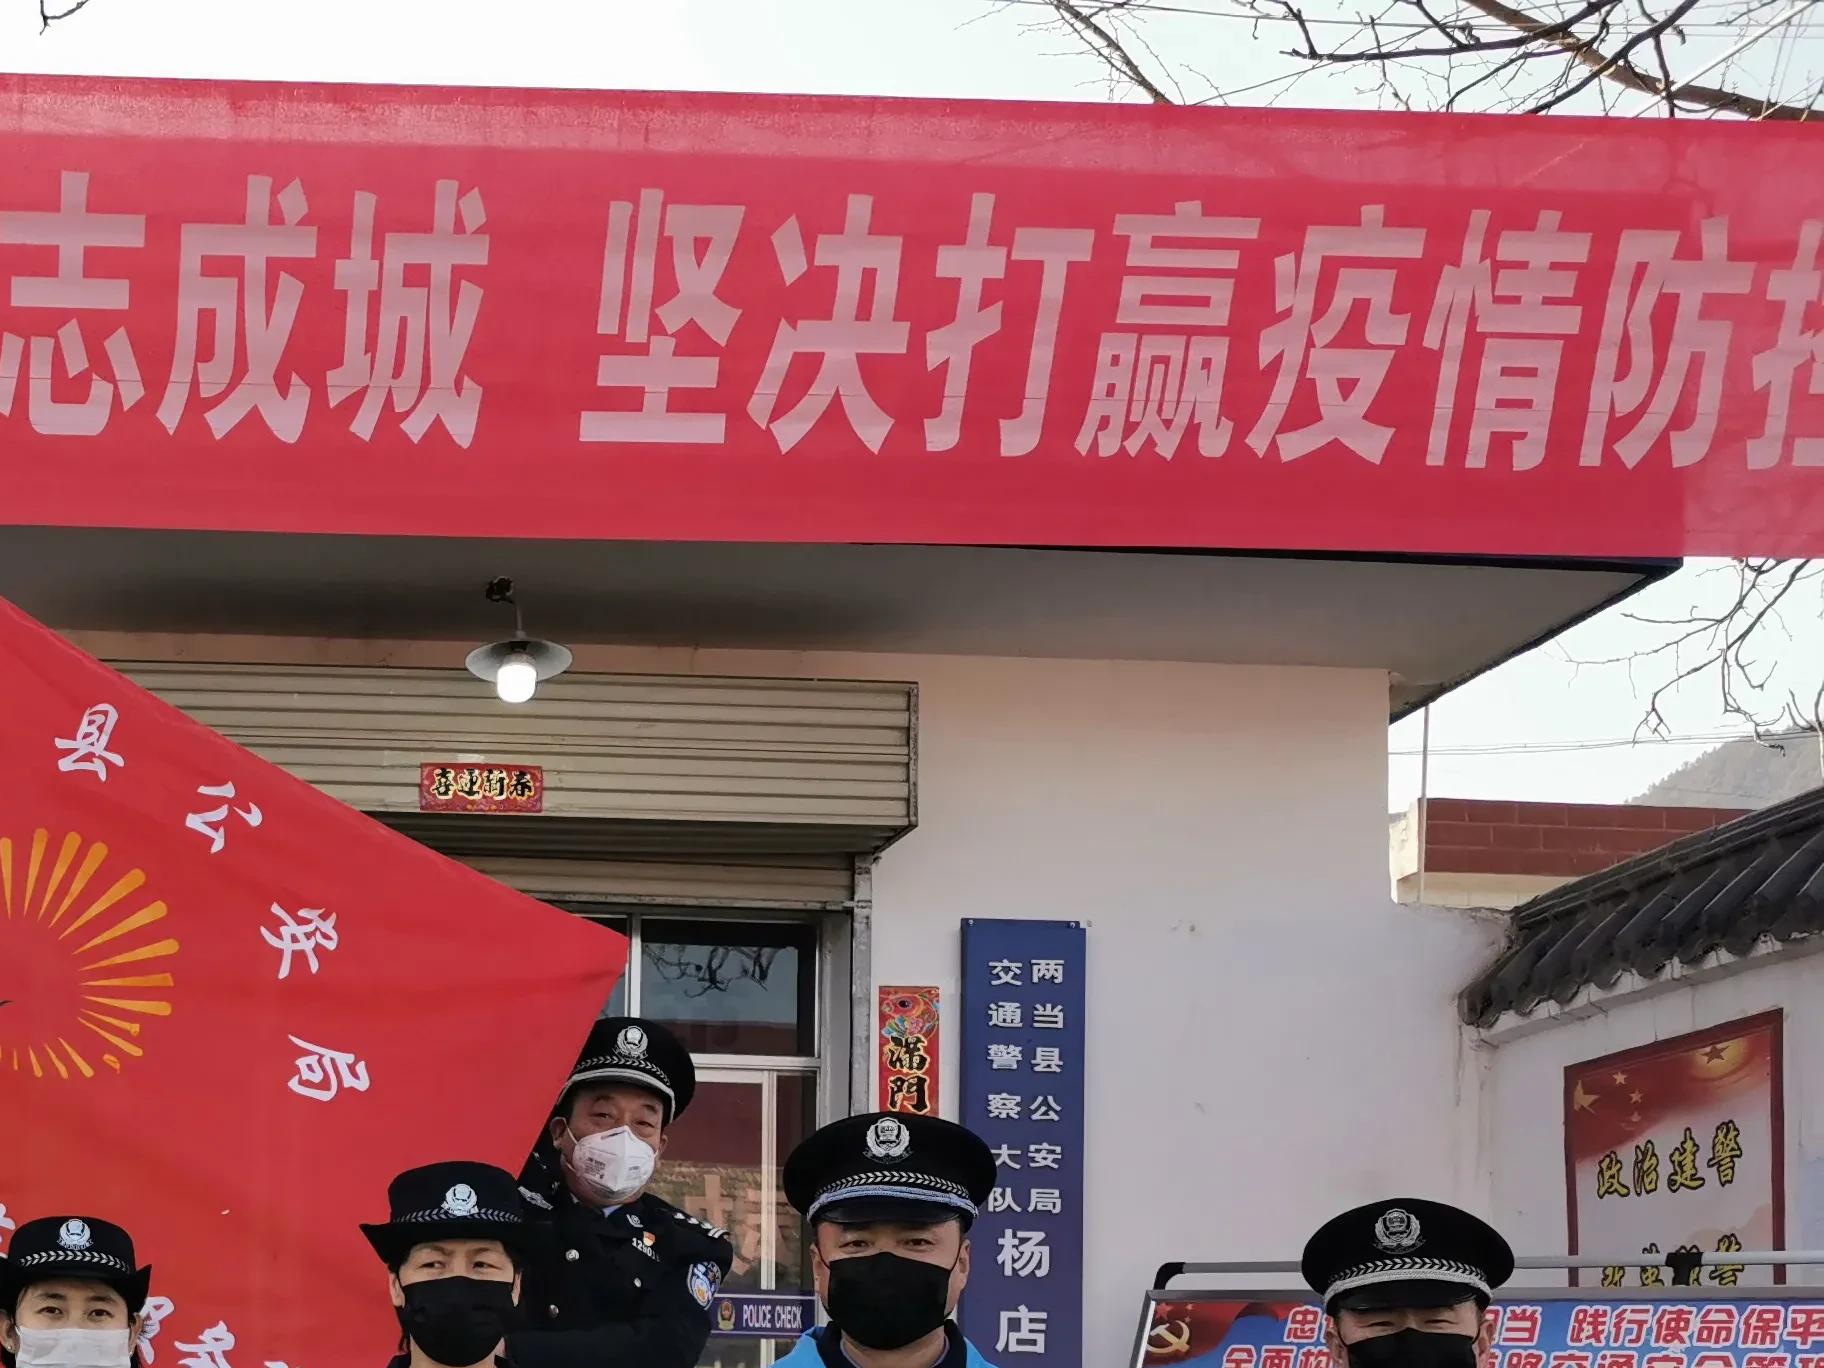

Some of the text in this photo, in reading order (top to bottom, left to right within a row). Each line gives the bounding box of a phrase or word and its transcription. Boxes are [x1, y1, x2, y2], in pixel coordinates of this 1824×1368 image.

[433, 767, 534, 799] 喜迎新春
[987, 959, 1023, 1213] 交通警察大队
[1026, 959, 1065, 1214] 两当县公安局
[1597, 1119, 1743, 1200] 政治建警
[742, 1304, 803, 1329] POLICE CHECK
[994, 1228, 1051, 1355] 杨店
